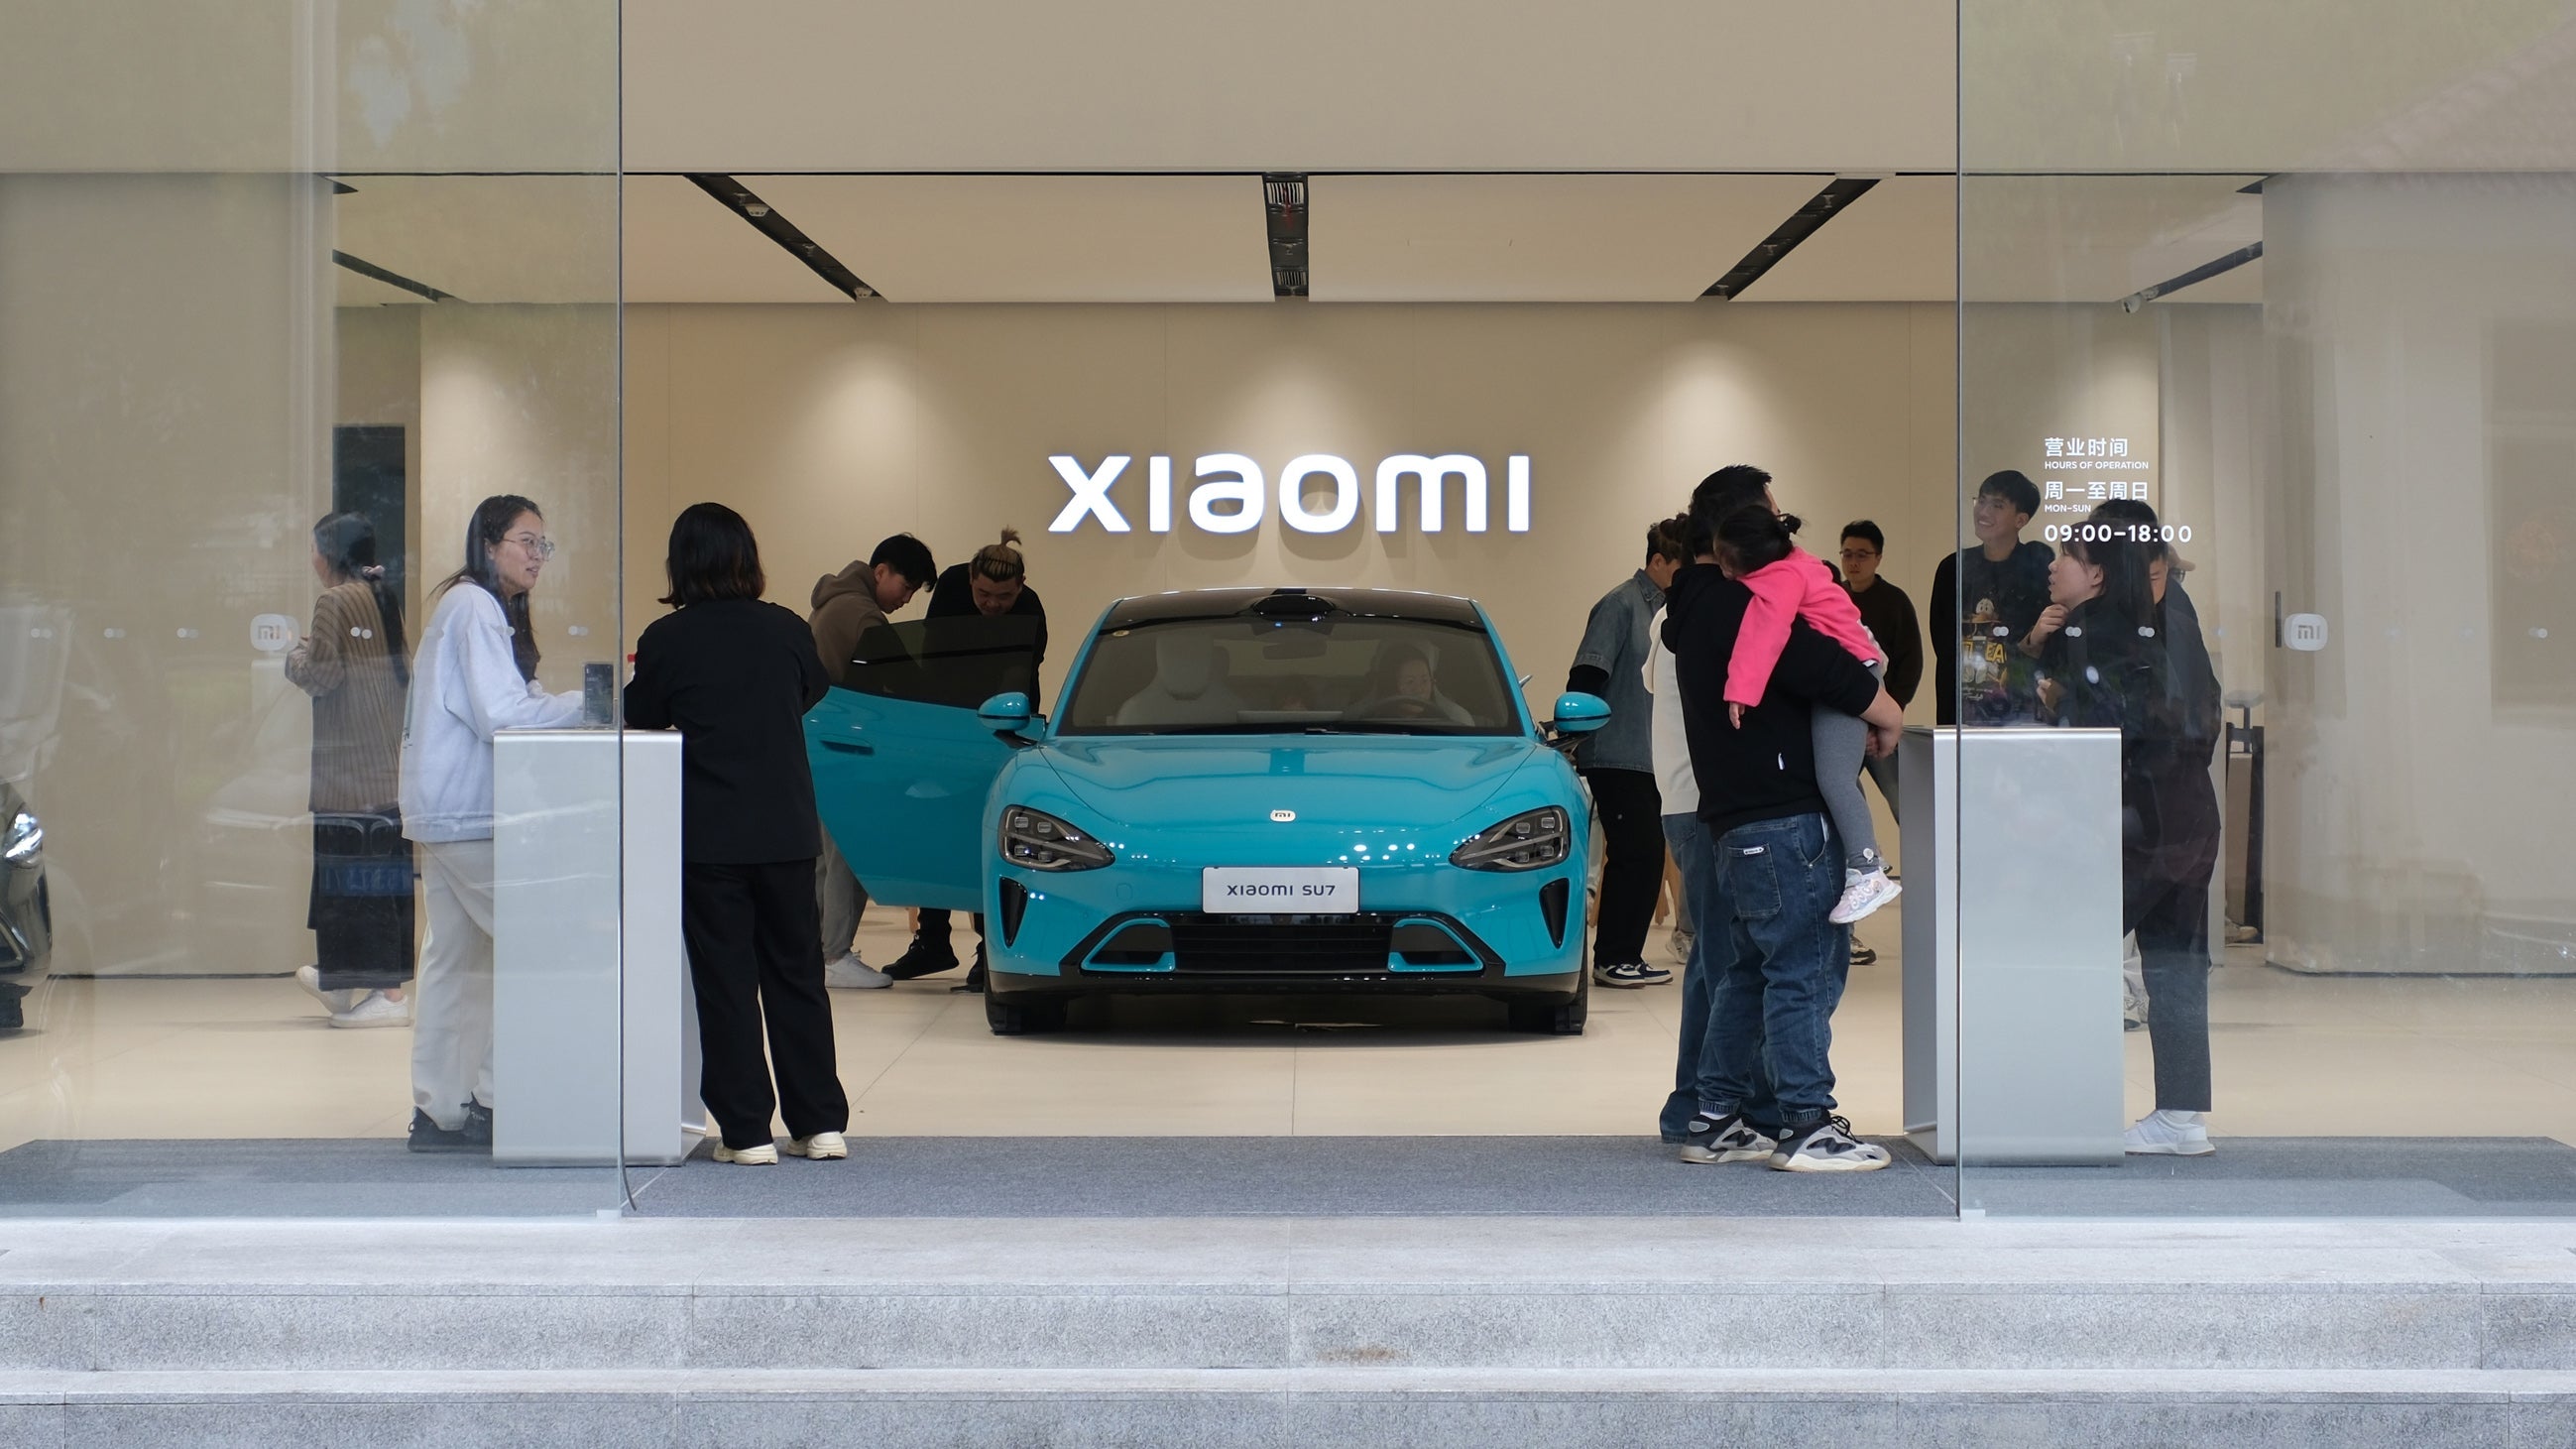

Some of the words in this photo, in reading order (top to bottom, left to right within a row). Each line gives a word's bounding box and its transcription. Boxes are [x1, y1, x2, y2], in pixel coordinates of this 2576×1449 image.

[2045, 437, 2128, 457] 营业时间
[2045, 481, 2148, 501] 周一至周日
[2045, 504, 2091, 513] MON-SUN
[2044, 524, 2192, 543] 09:00-18:00
[1302, 885, 1336, 896] SU7
